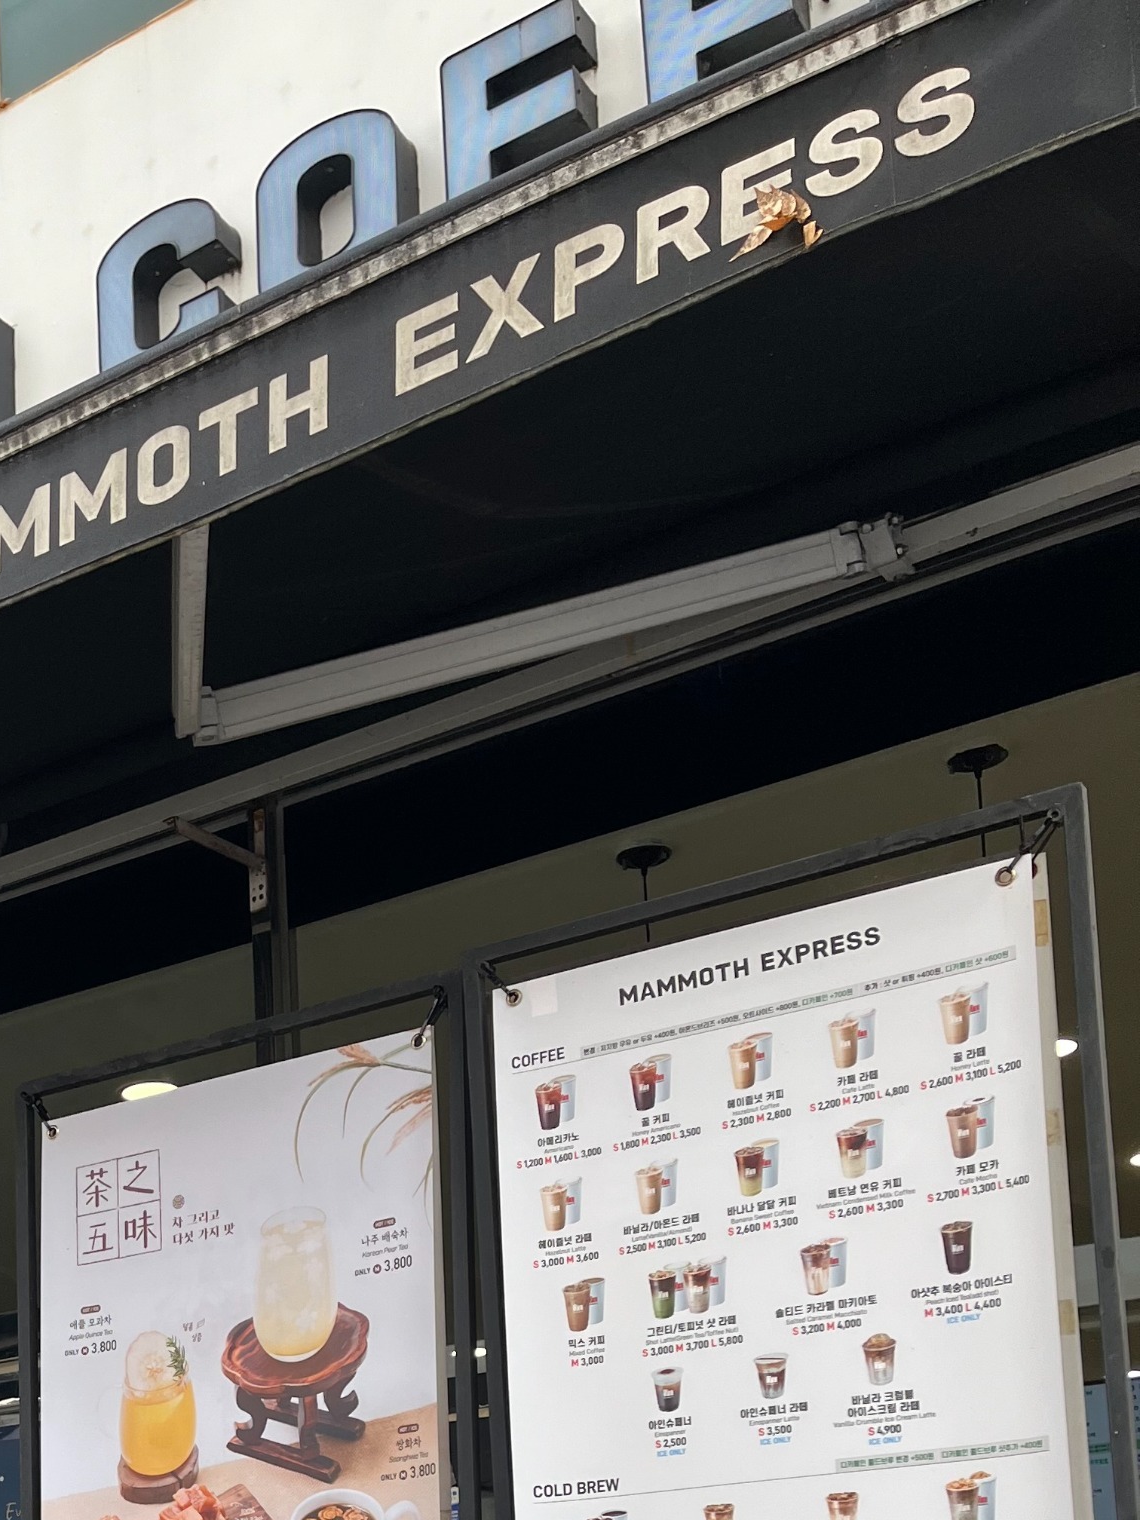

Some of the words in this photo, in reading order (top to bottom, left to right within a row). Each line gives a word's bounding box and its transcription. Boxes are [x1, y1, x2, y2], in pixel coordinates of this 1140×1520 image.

[395, 66, 976, 397] EXPRESS
[618, 958, 750, 1006] MAMMOTH
[760, 926, 881, 972] EXPRESS
[511, 1047, 565, 1069] COFFEE
[837, 1073, 856, 1087] 카페
[859, 1070, 879, 1082] 라떼
[929, 1075, 954, 1089] 2,600
[965, 1068, 988, 1081] 3,100
[997, 1059, 1022, 1074] 5,200
[727, 1093, 763, 1109] 헤이즐넛
[766, 1090, 784, 1101] 커피
[652, 1113, 670, 1125] 커피
[537, 1132, 580, 1147] 아메리카노
[620, 1140, 640, 1150] 1,800
[650, 1132, 672, 1145] 2,300
[680, 1127, 701, 1140] 3,500
[523, 1157, 544, 1168] 1,200
[553, 1152, 573, 1163] 1,600
[581, 1147, 602, 1159] 3,000
[828, 1184, 857, 1199] 베트남
[860, 1182, 879, 1195] 연유
[882, 1178, 902, 1189] 커피
[727, 1203, 755, 1217] 바나나
[757, 1199, 775, 1212] 달달
[778, 1196, 797, 1208] 커피
[173, 1216, 183, 1228] 차
[187, 1210, 220, 1226] 그리고
[173, 1230, 193, 1245] 다섯
[199, 1226, 219, 1240] 가지
[224, 1223, 235, 1234] 맛
[361, 1234, 379, 1246] 나주
[382, 1227, 408, 1242] 배숙차
[355, 1267, 370, 1276] ONLY
[384, 1255, 412, 1271] 3,800
[541, 1257, 564, 1269] 3,000
[575, 1252, 599, 1263] 3,600
[776, 1306, 804, 1318] 솔티드
[806, 1301, 835, 1313] 카라멜
[838, 1295, 878, 1309] 마키아토
[70, 1320, 85, 1330] 애플
[88, 1314, 112, 1327] 모과차
[91, 1340, 116, 1354] 3,800
[740, 1404, 786, 1418] 아인슈페너
[789, 1402, 808, 1413] 라떼
[847, 1404, 897, 1418] 아이스크림
[900, 1401, 920, 1412] 라떼
[648, 1417, 692, 1430] 아인슈페너
[767, 1425, 792, 1436] 3,500
[396, 1436, 421, 1451] 쌍화차
[663, 1437, 687, 1448] 2,500
[381, 1473, 397, 1481] ONLY
[410, 1462, 436, 1478] 3,800
[533, 1483, 572, 1498] COLD
[577, 1478, 619, 1494] BREW
